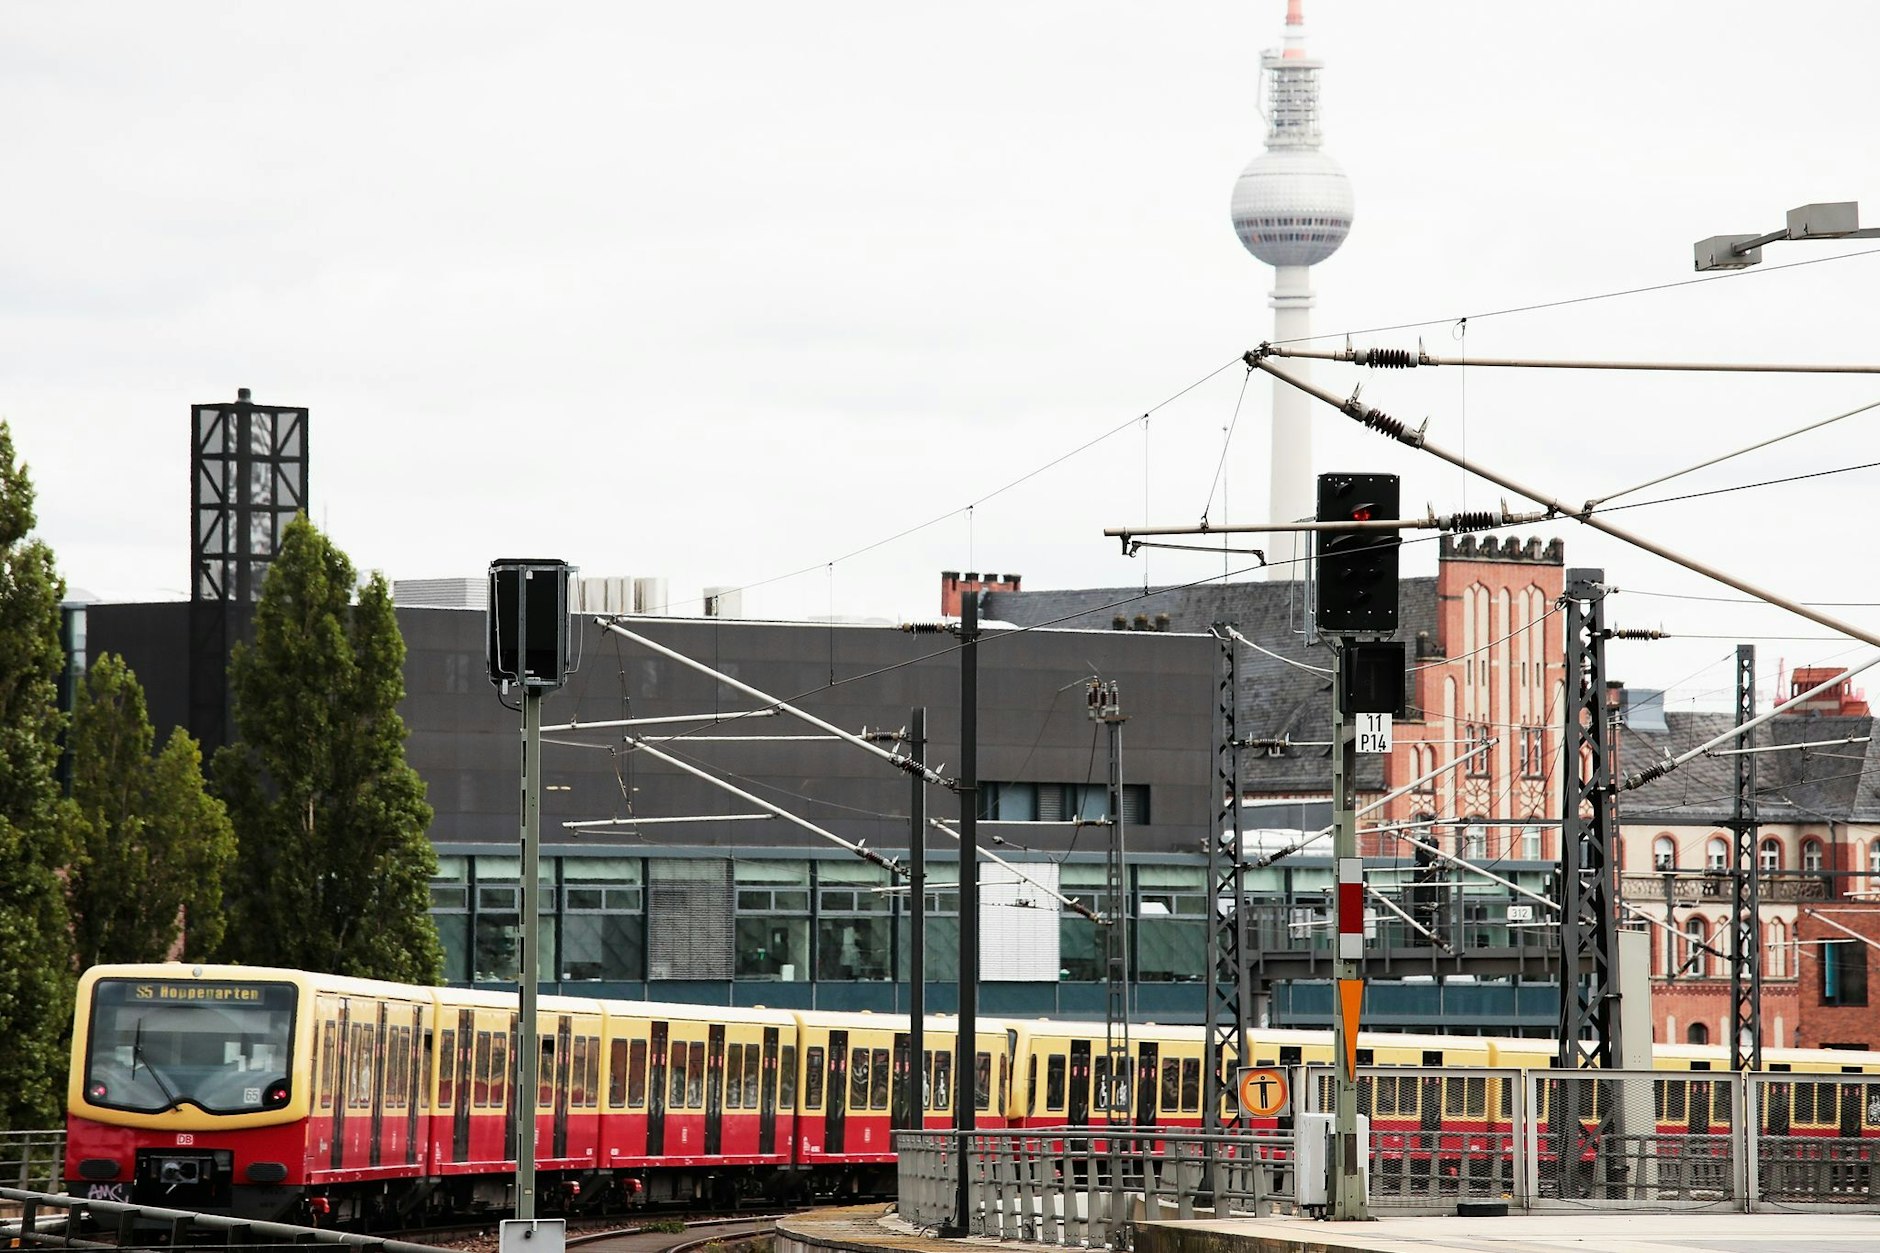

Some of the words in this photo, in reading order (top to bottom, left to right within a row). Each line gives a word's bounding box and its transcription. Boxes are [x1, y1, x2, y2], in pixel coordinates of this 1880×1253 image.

[1367, 714, 1382, 732] 11
[1361, 734, 1387, 751] P14
[1511, 908, 1528, 919] 312
[135, 985, 154, 999] S5
[245, 1089, 259, 1102] 65
[177, 1134, 193, 1145] DB
